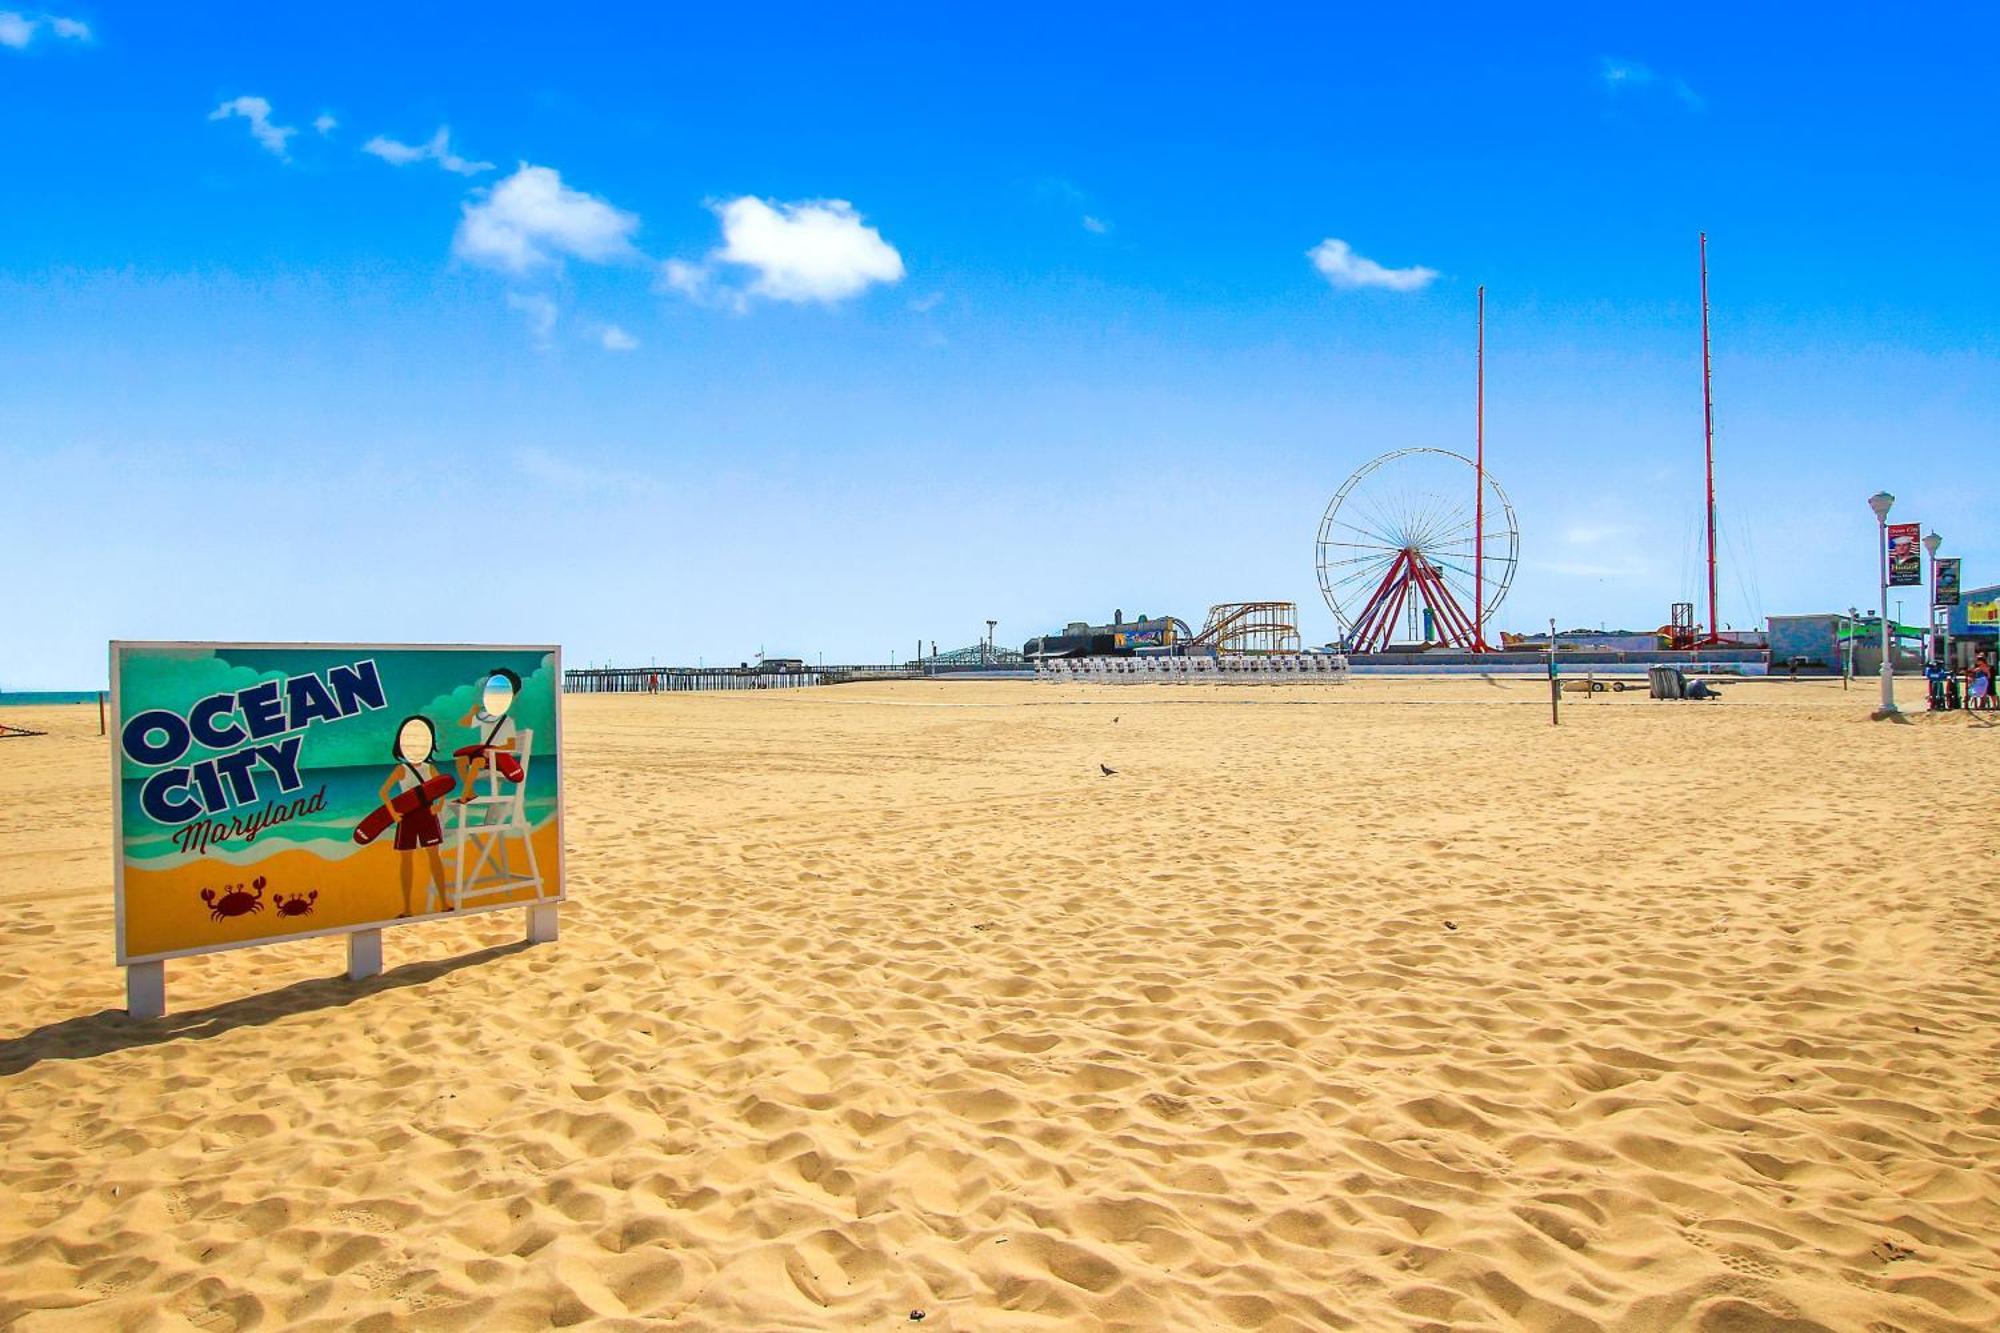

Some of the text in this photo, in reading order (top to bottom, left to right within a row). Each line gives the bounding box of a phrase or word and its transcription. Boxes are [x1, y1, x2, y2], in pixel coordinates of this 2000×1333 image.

[122, 658, 388, 767] OCEAN
[140, 734, 304, 826] CITY
[172, 784, 328, 855] Maryland
